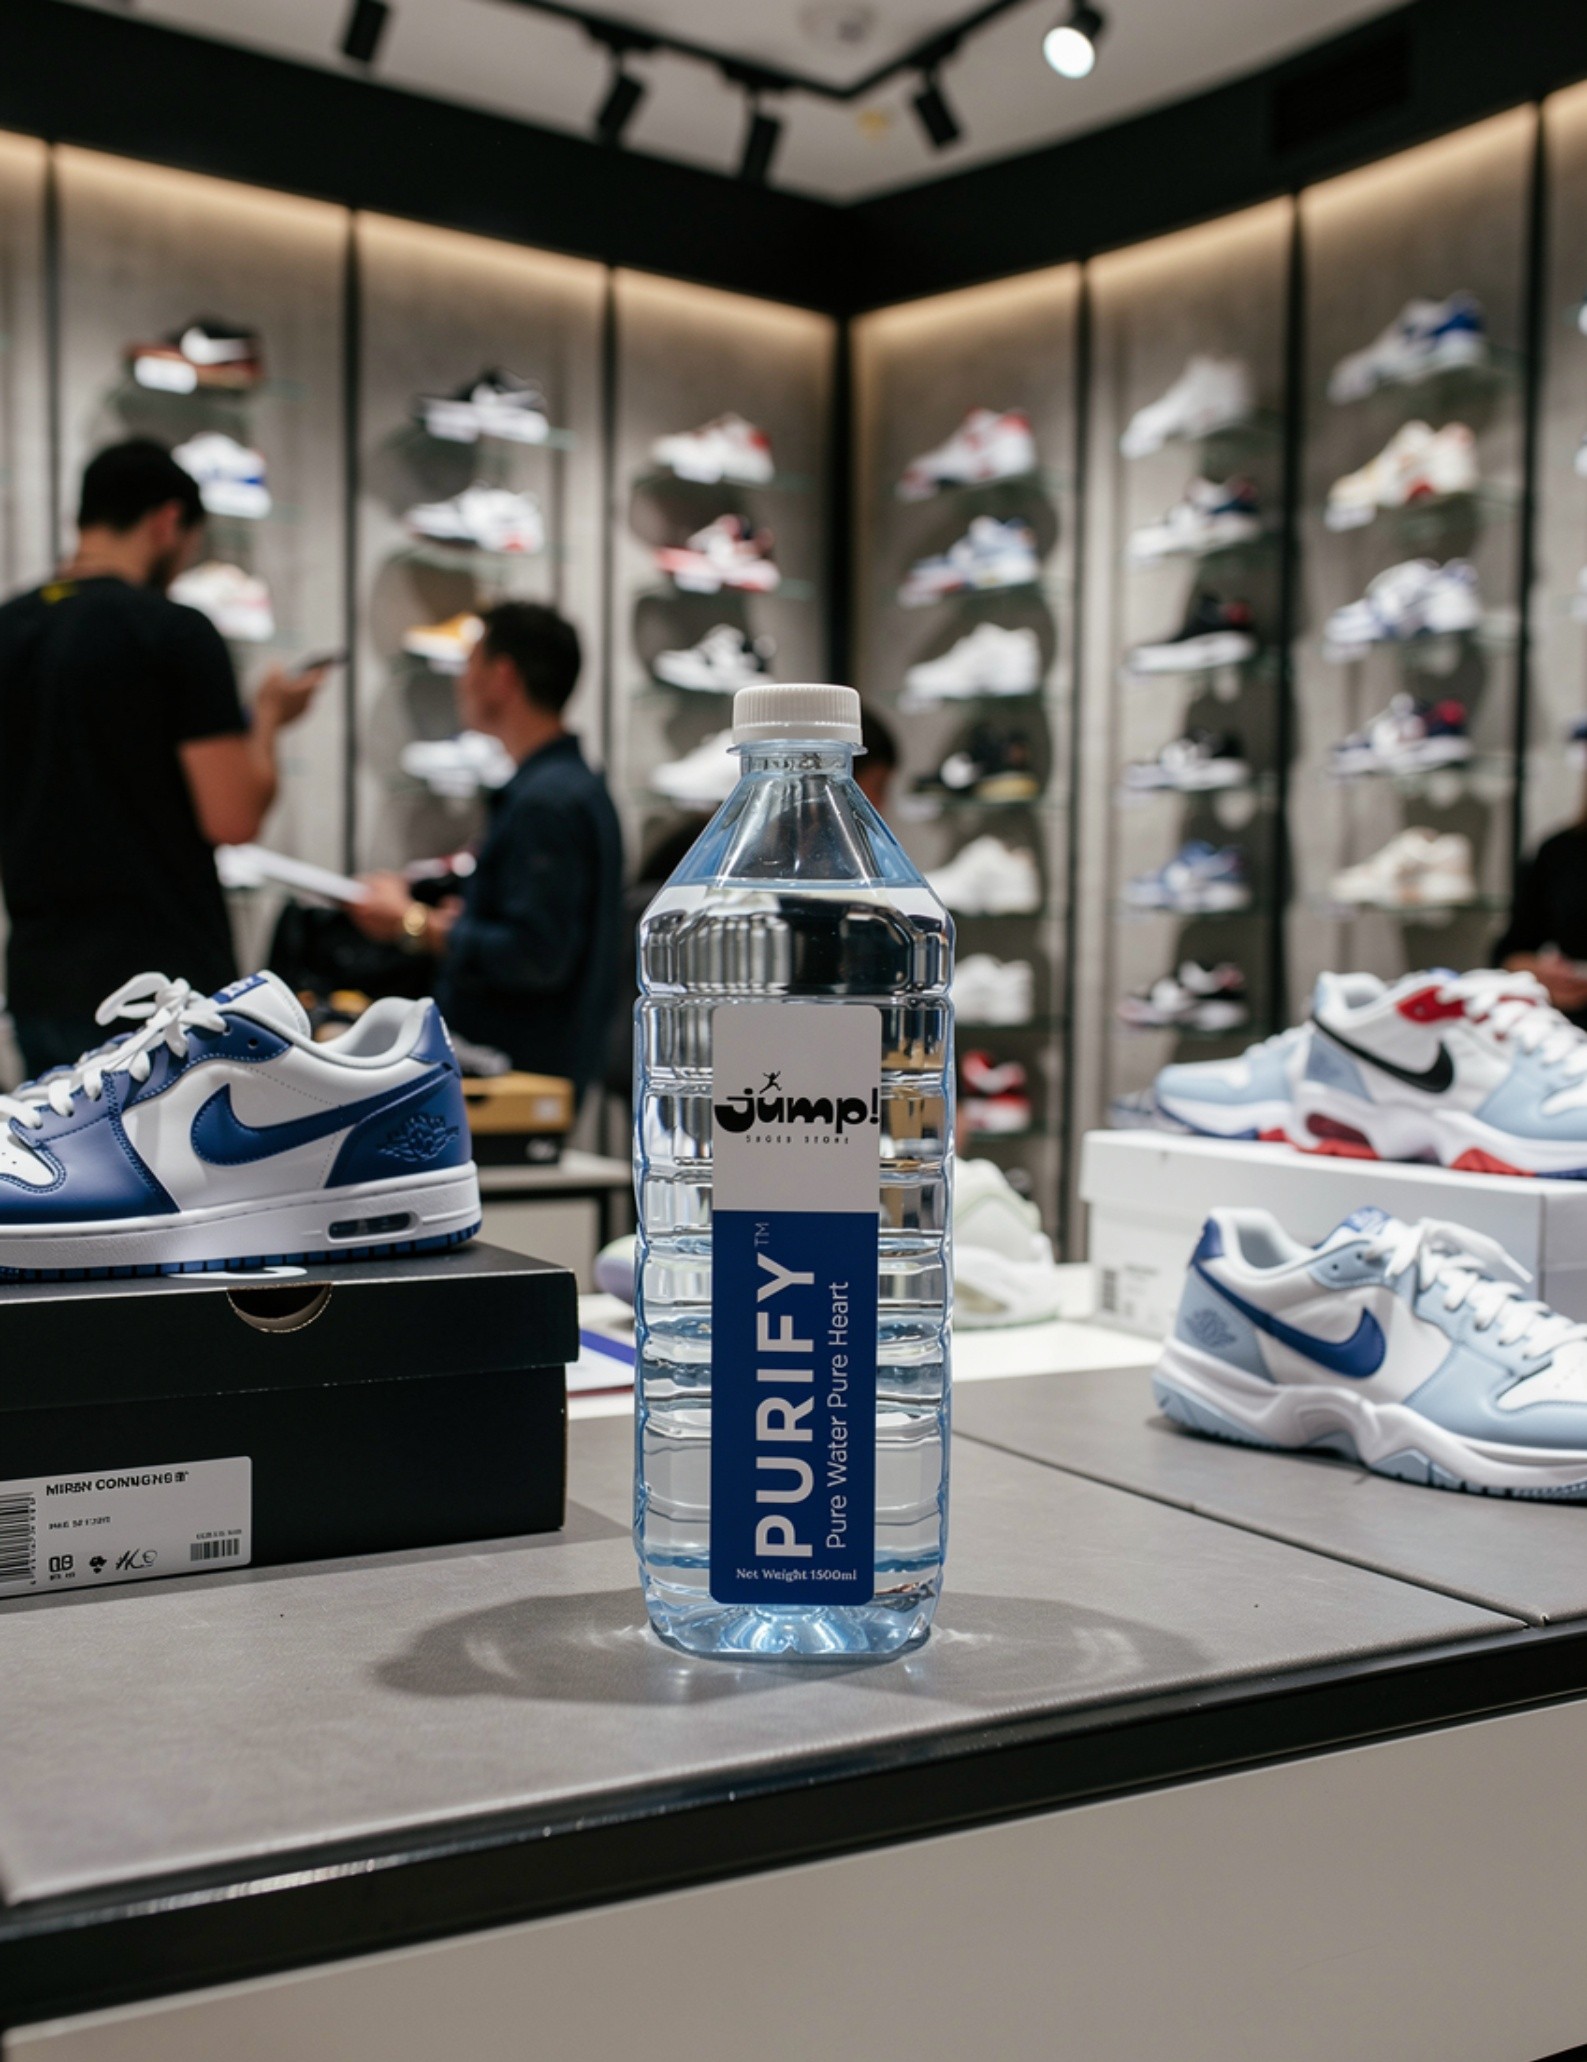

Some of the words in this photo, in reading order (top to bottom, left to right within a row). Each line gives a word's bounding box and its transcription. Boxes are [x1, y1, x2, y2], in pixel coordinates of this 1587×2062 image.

[714, 1087, 879, 1134] jump!
[827, 1281, 849, 1346] Heart
[754, 1251, 815, 1558] PURIFY
[826, 1354, 849, 1408] Pure
[826, 1414, 849, 1488] Water
[825, 1494, 848, 1549] Pure
[736, 1567, 760, 1580] Net
[761, 1568, 808, 1583] Weight
[810, 1568, 858, 1581] 1500ml
